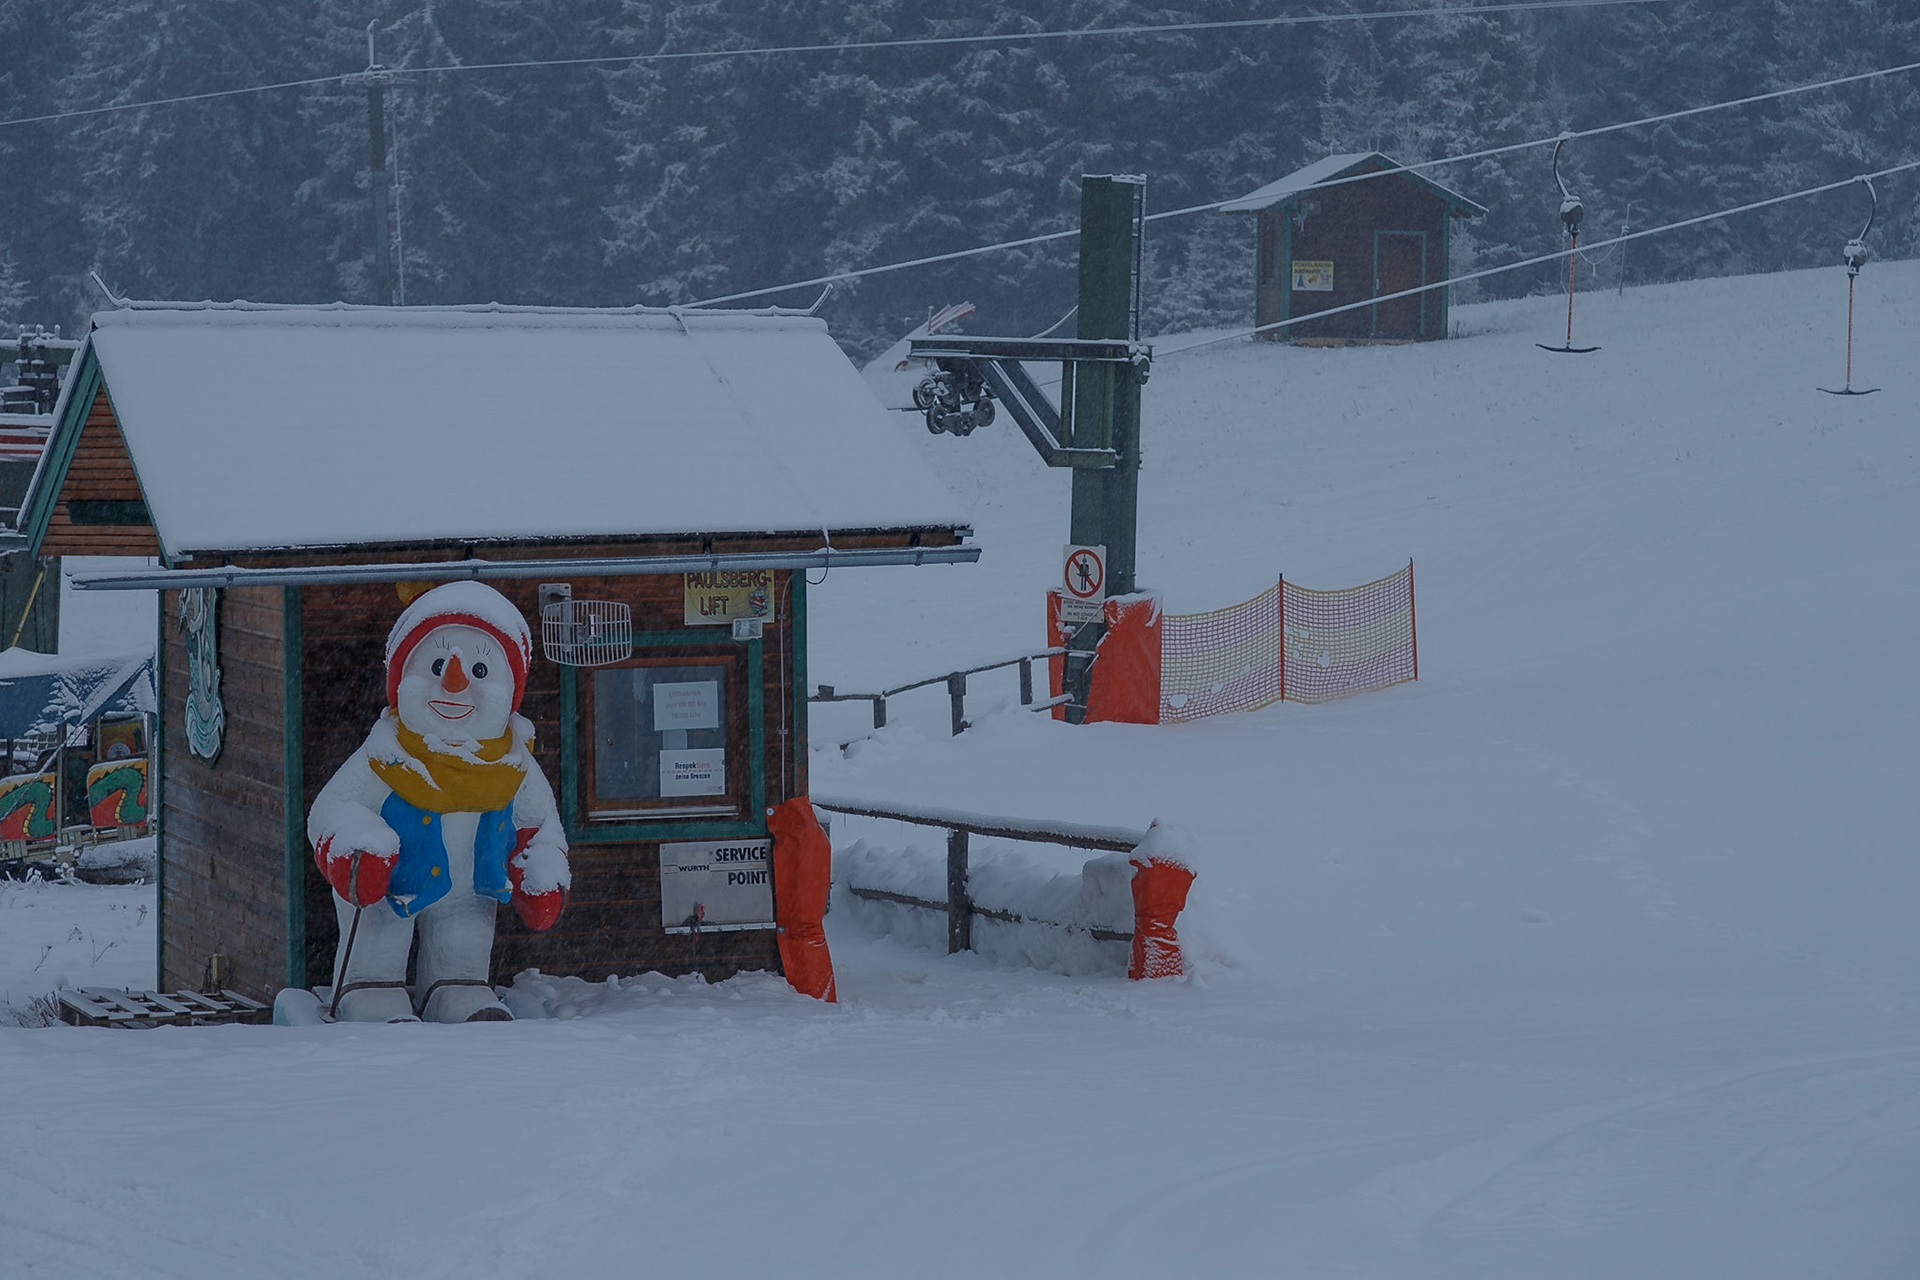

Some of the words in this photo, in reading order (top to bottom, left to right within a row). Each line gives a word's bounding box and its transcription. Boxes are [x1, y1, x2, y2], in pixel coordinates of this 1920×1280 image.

[687, 569, 772, 589] PAULSBERG-
[700, 596, 729, 616] LIFT
[715, 846, 766, 861] SERVICE
[728, 871, 768, 885] POINT
